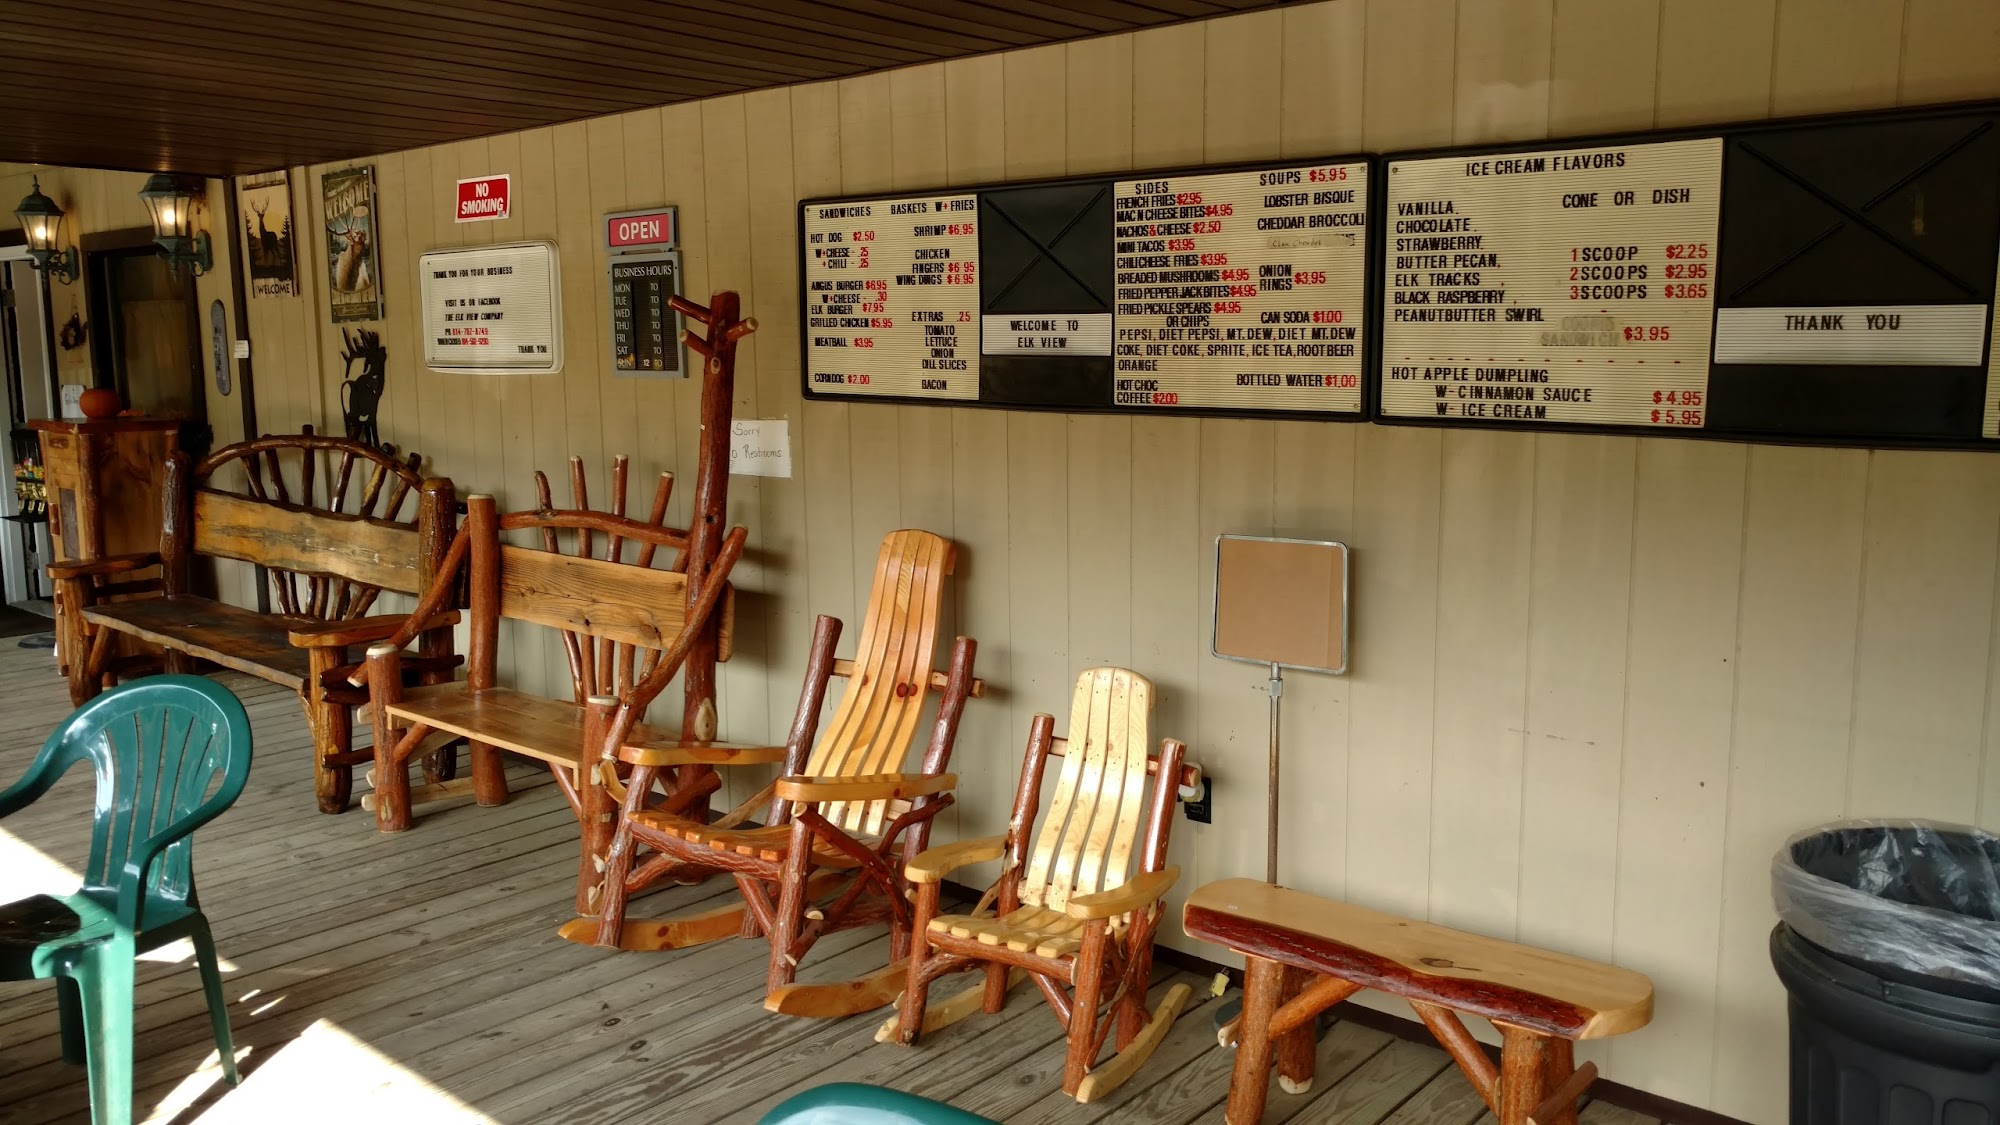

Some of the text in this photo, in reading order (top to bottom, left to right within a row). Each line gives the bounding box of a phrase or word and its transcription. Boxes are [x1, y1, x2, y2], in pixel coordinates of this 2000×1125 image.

[1466, 152, 1626, 176] ICE CREAM FLAVORS
[1259, 167, 1347, 187] SOUPS $5.95
[475, 182, 489, 197] NO
[1135, 181, 1169, 195] SIDES
[325, 180, 370, 221] WELCOME
[1116, 192, 1202, 210] FRENCH FRIES $2.95
[1263, 190, 1355, 208] LOBSTER BISQUE
[1562, 188, 1691, 209] CONE OR DISH
[461, 197, 504, 215] SMOKING
[819, 206, 871, 219] SANDWICHES
[890, 199, 974, 215] BASKETS FRIES
[1116, 203, 1233, 222] MAC CHEESE BITES $4.95
[1257, 212, 1365, 231] CHEDDAR BROCCOLI
[619, 219, 660, 241] OPEN
[913, 223, 974, 237] SHRIMP $6.95
[1116, 220, 1221, 238] NACHOS CHEESE $2.50
[810, 230, 875, 244] HOT DOG $2.50
[1117, 238, 1195, 254] MINI TACOS $3.95
[1582, 243, 1708, 262] SCOOP $2.25
[914, 248, 950, 260] CHICKEN
[1173, 254, 1199, 267] FRIES
[911, 262, 945, 274] FINGERS
[1396, 255, 1447, 269] BUTTER
[470, 268, 484, 276] YOUR
[487, 266, 513, 276] BUSINESS
[614, 264, 672, 278] BUSINESS HOURS
[1117, 268, 1250, 285] BREADED MUSHROOMS $4.95
[1259, 264, 1292, 278] ONION
[1665, 263, 1708, 279] $2.95
[614, 282, 659, 292] MON TO
[811, 279, 887, 291] ANGUS BURGER $6.95
[895, 274, 943, 286] WING DINGS
[1259, 271, 1327, 291] RINGS $3.95
[1395, 273, 1419, 287] ELK
[257, 283, 291, 295] WELCOME
[1118, 286, 1178, 300] FRIED PEPPER
[1664, 283, 1708, 299] $3.65
[445, 299, 457, 307] VISIT
[478, 297, 501, 306] FACEBOOK
[615, 295, 659, 305] TUE TO
[1395, 291, 1430, 305] BLACK
[615, 308, 660, 318] WED TO
[811, 304, 853, 315] ELK BURGER
[1118, 301, 1242, 315] FRIED PICKLE SPEARS $4.95
[1504, 308, 1545, 322] SWIRL
[455, 313, 464, 321] ELK
[466, 313, 478, 321] VIEW
[480, 312, 503, 320] COMPANY
[810, 317, 893, 328] GRILLED CHICKEN $5.95
[911, 311, 944, 322] EXTRAS
[1166, 315, 1210, 328] OR CHIPS
[1260, 310, 1342, 324] CAN SODA $1.00
[1785, 314, 1901, 331] THANK YOU
[615, 321, 661, 330] THU TO
[924, 324, 955, 336] TOMATO
[1010, 320, 1079, 331] WELCOME TO
[616, 333, 661, 343] FRI TO
[1158, 328, 1184, 341] DIET
[1278, 327, 1306, 340] DIET
[1623, 326, 1670, 342] $3.95
[814, 337, 848, 348] MEATBALL
[925, 336, 958, 347] LETTUCE
[1017, 336, 1067, 348] ELK VIEW
[537, 345, 547, 354] YOU
[617, 346, 662, 355] SAT TO
[930, 347, 955, 358] ONION
[1146, 345, 1169, 356] DIET
[1252, 344, 1270, 356] ICE
[643, 358, 650, 367] 12
[654, 358, 663, 368] TO
[938, 359, 967, 371] SLICES
[1118, 359, 1158, 372] ORANGE
[847, 374, 870, 385] $2.00
[1236, 374, 1357, 388] BOTTLED WATER $1.00
[1391, 367, 1549, 383] HOT APPLE DUMPLING
[921, 379, 947, 390] BACON
[1116, 379, 1159, 391] HOT CHOC
[1116, 391, 1152, 404] COFFEE
[1458, 385, 1592, 402] CINNAMON SAUCE
[1462, 403, 1546, 419] ICE CREAM
[732, 422, 760, 438] Sorry
[742, 443, 782, 460] Restrooms
